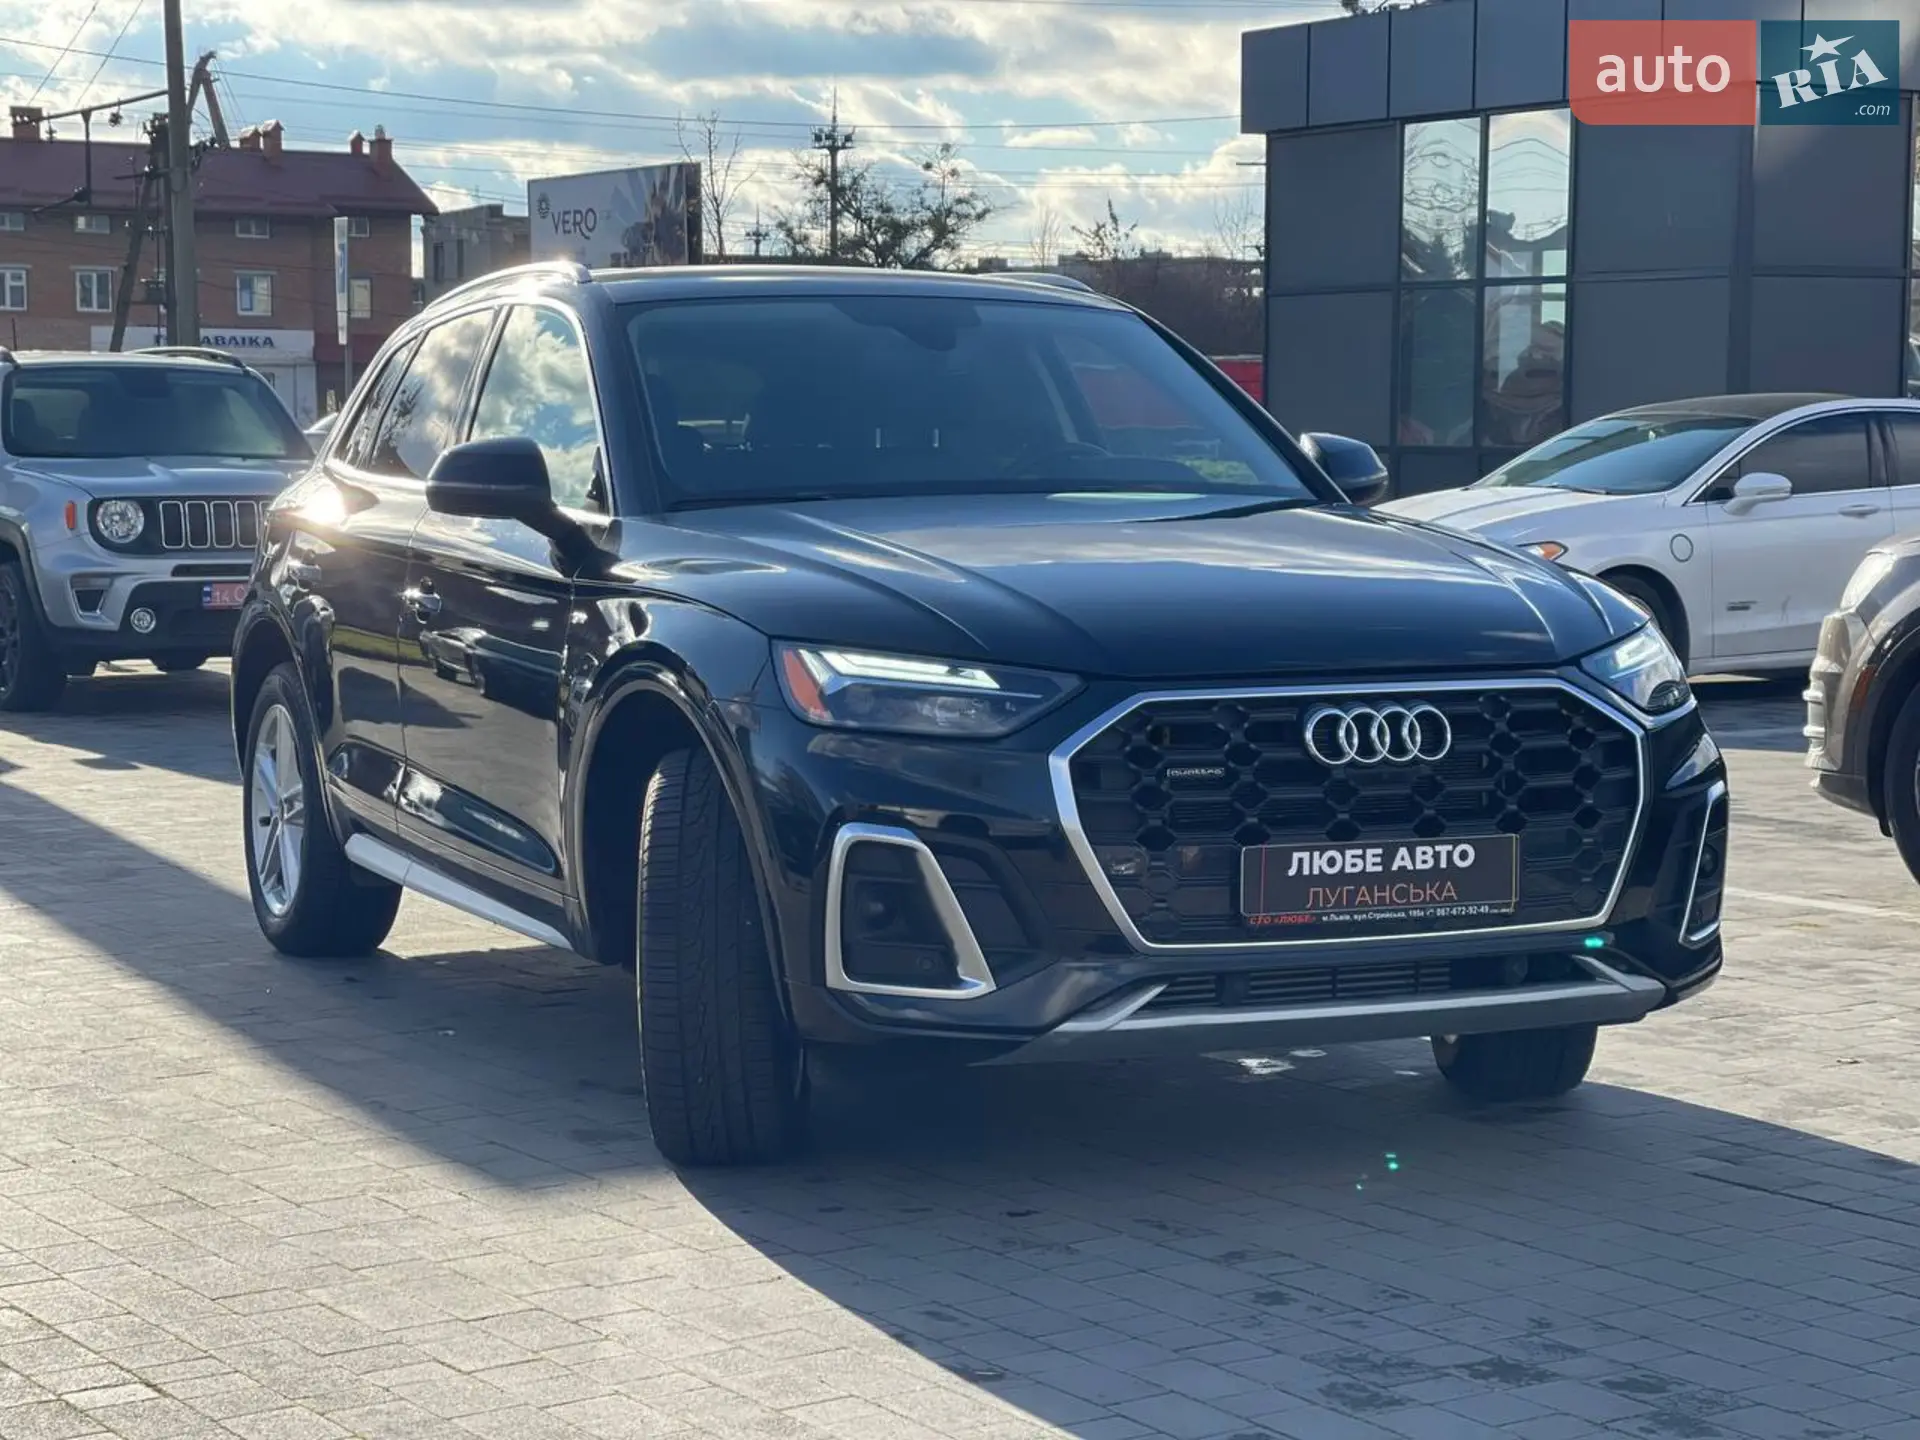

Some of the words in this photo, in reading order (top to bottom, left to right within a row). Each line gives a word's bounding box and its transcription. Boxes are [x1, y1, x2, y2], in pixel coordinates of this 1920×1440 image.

[551, 207, 597, 240] VERO
[1288, 848, 1383, 876] ЛЮБЕ
[1391, 844, 1476, 871] АВТО
[1305, 881, 1458, 909] ЛУГАНСЬКА
